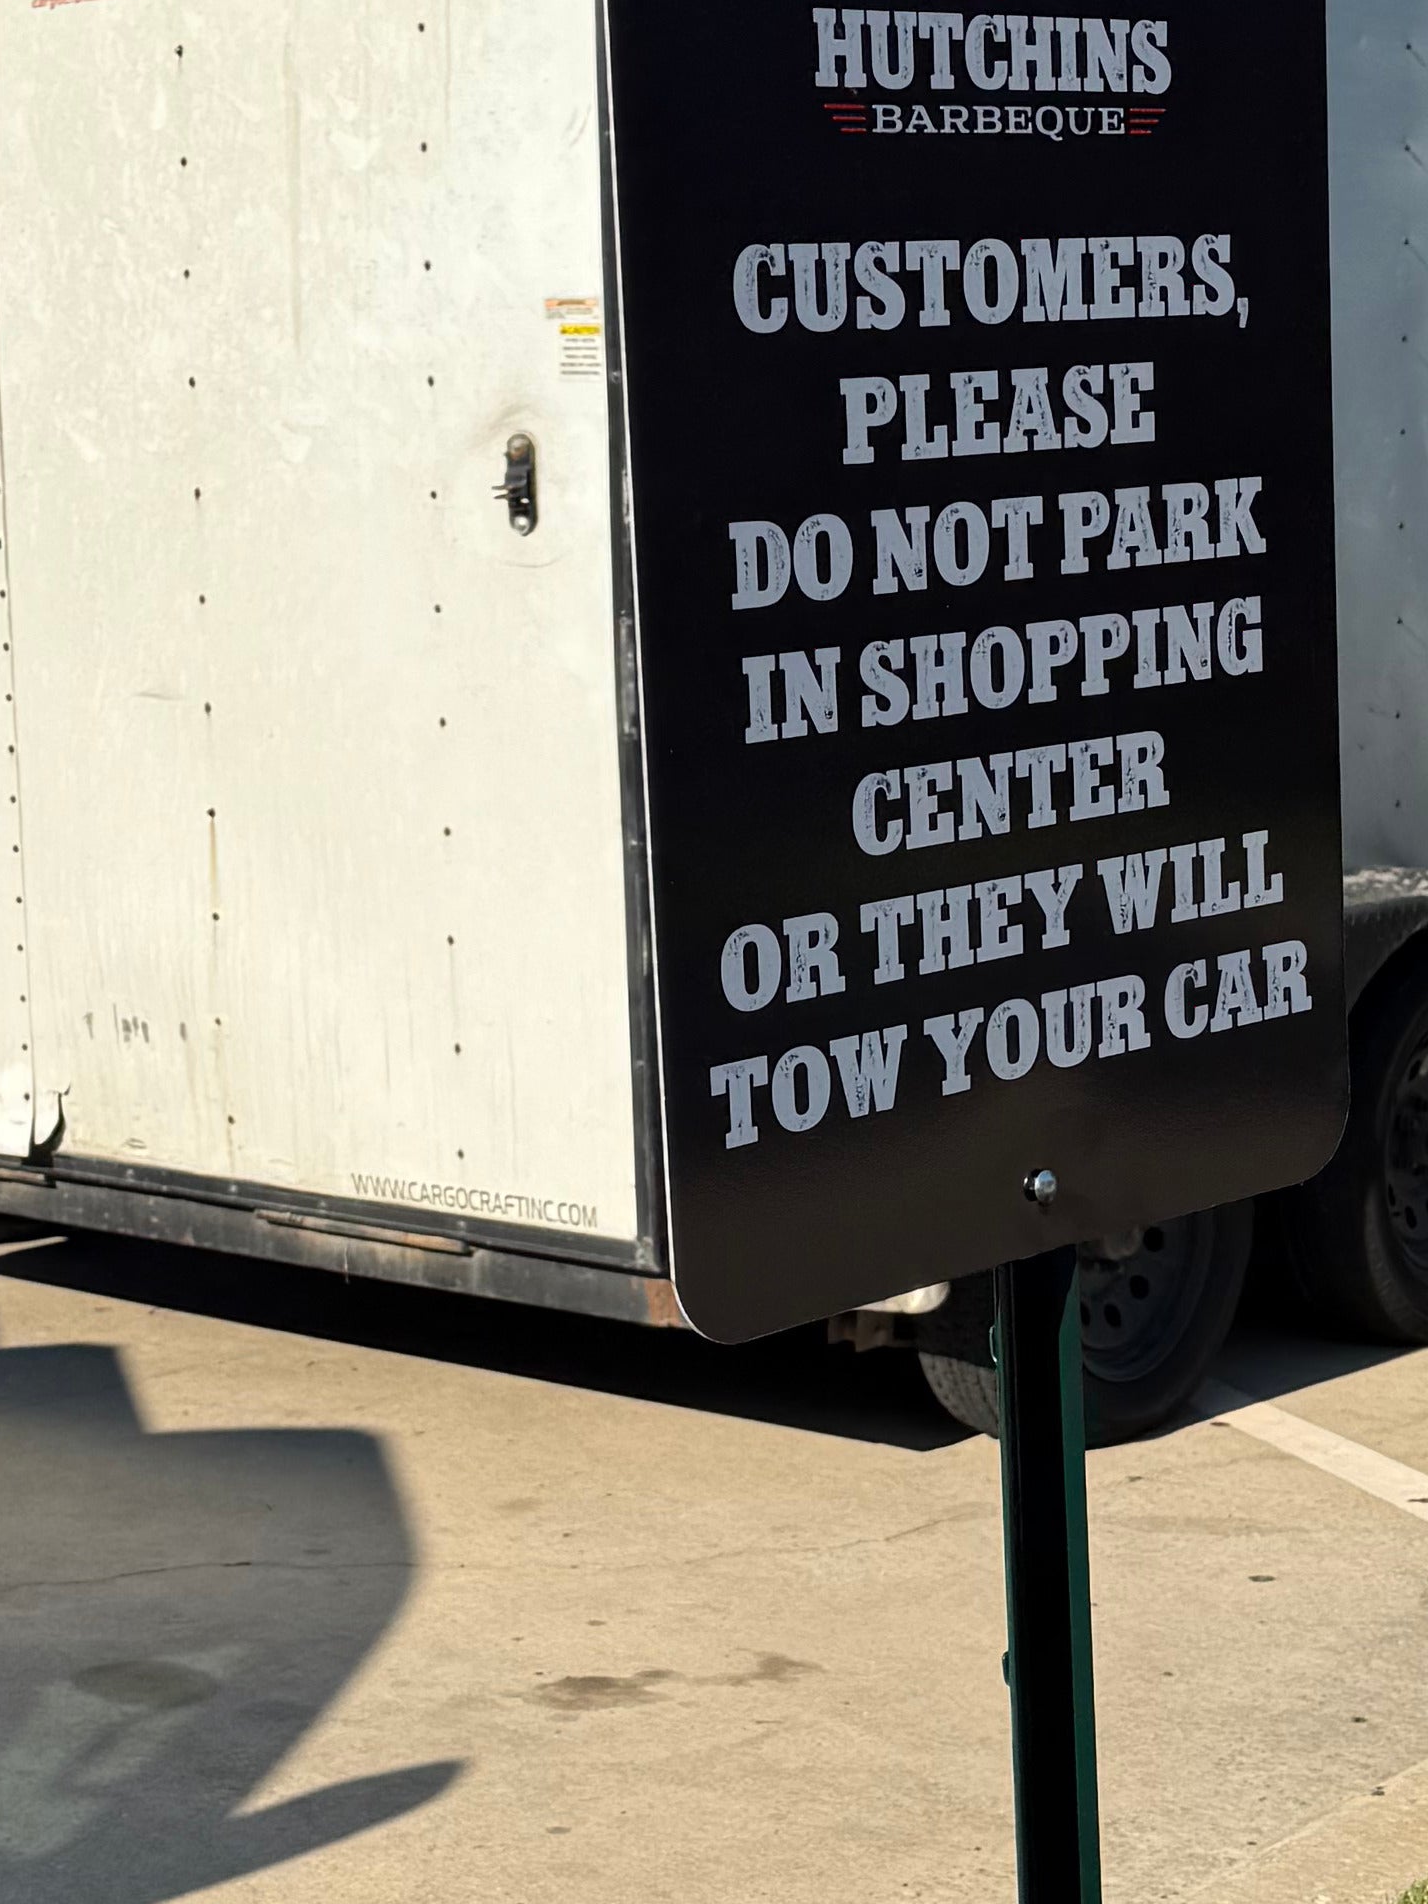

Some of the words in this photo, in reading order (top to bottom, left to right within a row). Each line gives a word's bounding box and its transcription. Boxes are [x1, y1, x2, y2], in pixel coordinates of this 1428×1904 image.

[812, 7, 1172, 95] HUTCHINS
[871, 104, 1126, 142] BARBEQUE
[733, 233, 1249, 334] CUSTOMERS,
[839, 361, 1156, 465] PLEASE
[728, 513, 854, 610] DO
[870, 495, 1044, 595] NOT
[1058, 476, 1267, 575] PARK
[742, 646, 841, 744] IN
[859, 595, 1264, 728] SHOPPING
[852, 730, 1170, 856] CENTER
[720, 912, 846, 1012] OR
[859, 863, 1084, 985] THEY
[1096, 829, 1284, 935] WILL
[709, 1023, 908, 1150] TOW
[923, 974, 1151, 1097] YOUR
[1164, 940, 1313, 1039] CAR
[351, 1172, 598, 1228] WWW.CARGOCRAFTINC.COM
